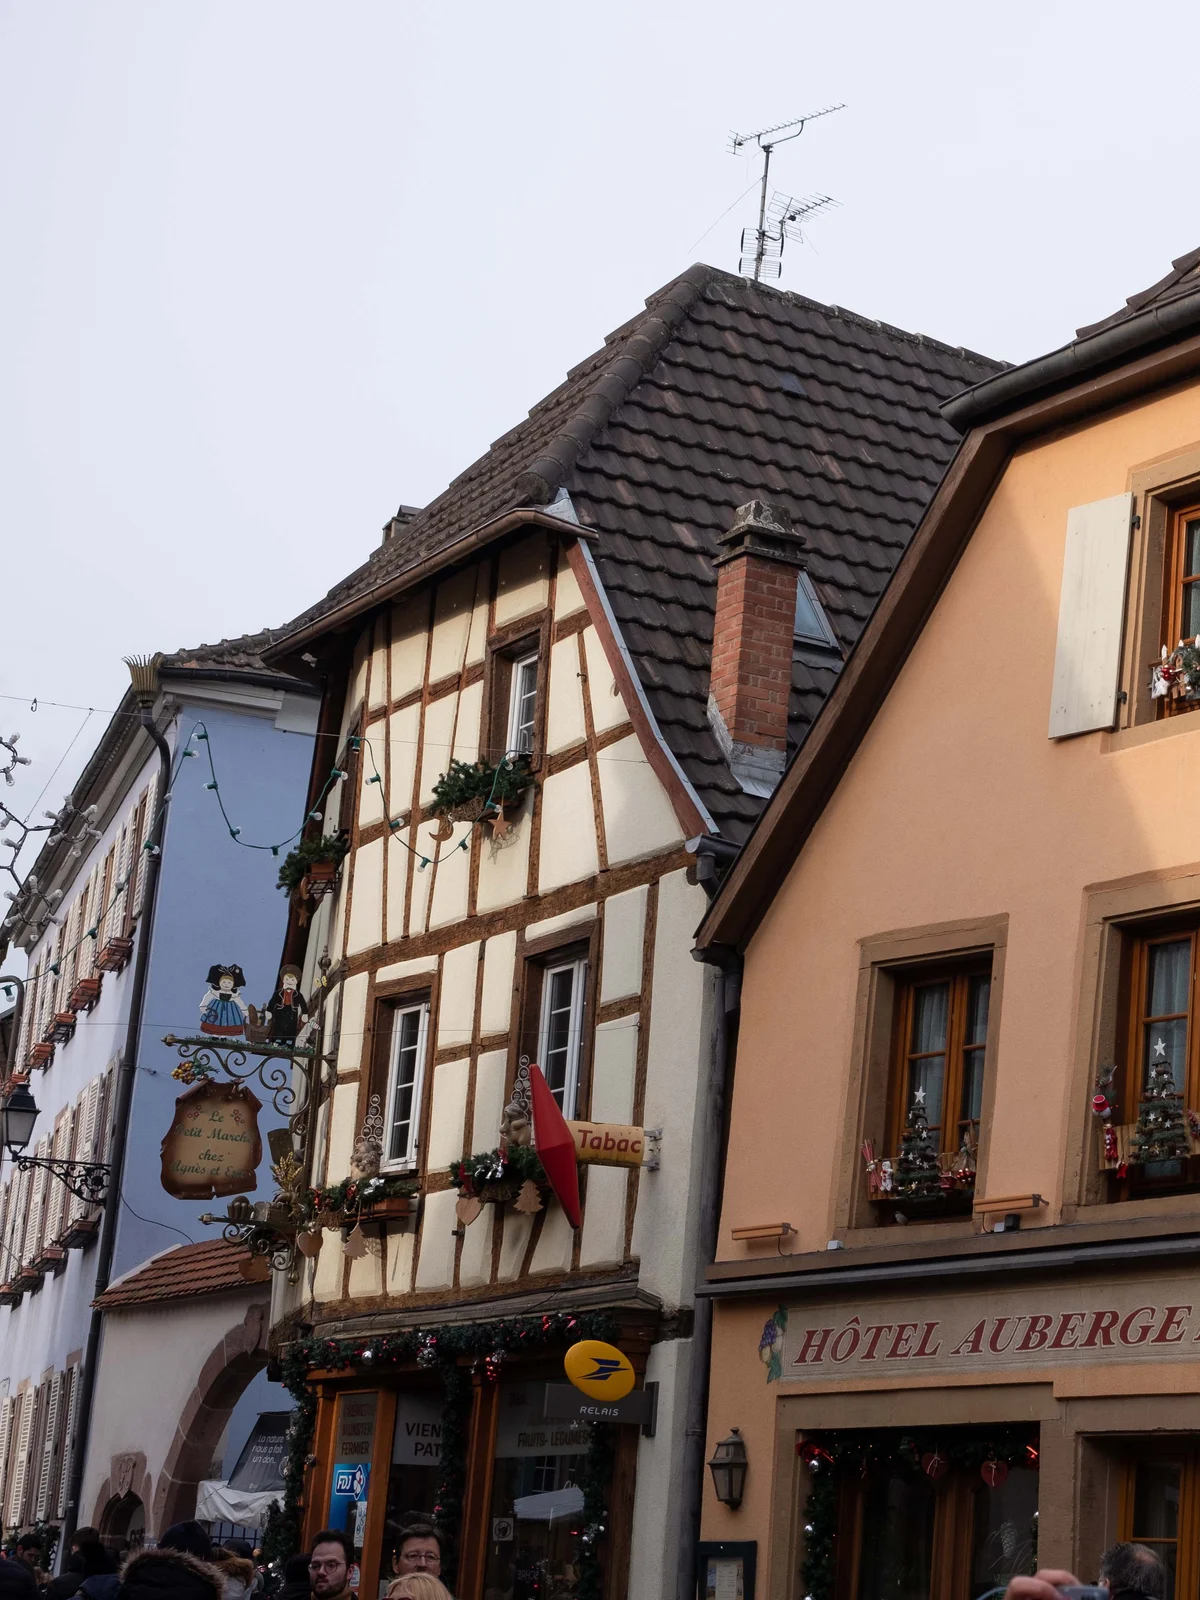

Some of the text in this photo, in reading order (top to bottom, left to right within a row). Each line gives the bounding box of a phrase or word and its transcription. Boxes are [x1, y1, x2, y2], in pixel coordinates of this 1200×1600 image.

[208, 1110, 224, 1123] Le
[578, 1128, 642, 1154] Tabac
[198, 1148, 225, 1163] chez
[170, 1160, 206, 1176] Agnès
[209, 1165, 221, 1176] et
[792, 1315, 941, 1365] HÔTEL
[950, 1305, 1193, 1357] AUBERGE
[579, 1406, 619, 1416] RELAIS
[251, 1445, 267, 1453] nous
[341, 1442, 370, 1456] FERMIER
[337, 1475, 352, 1490] FDJ
